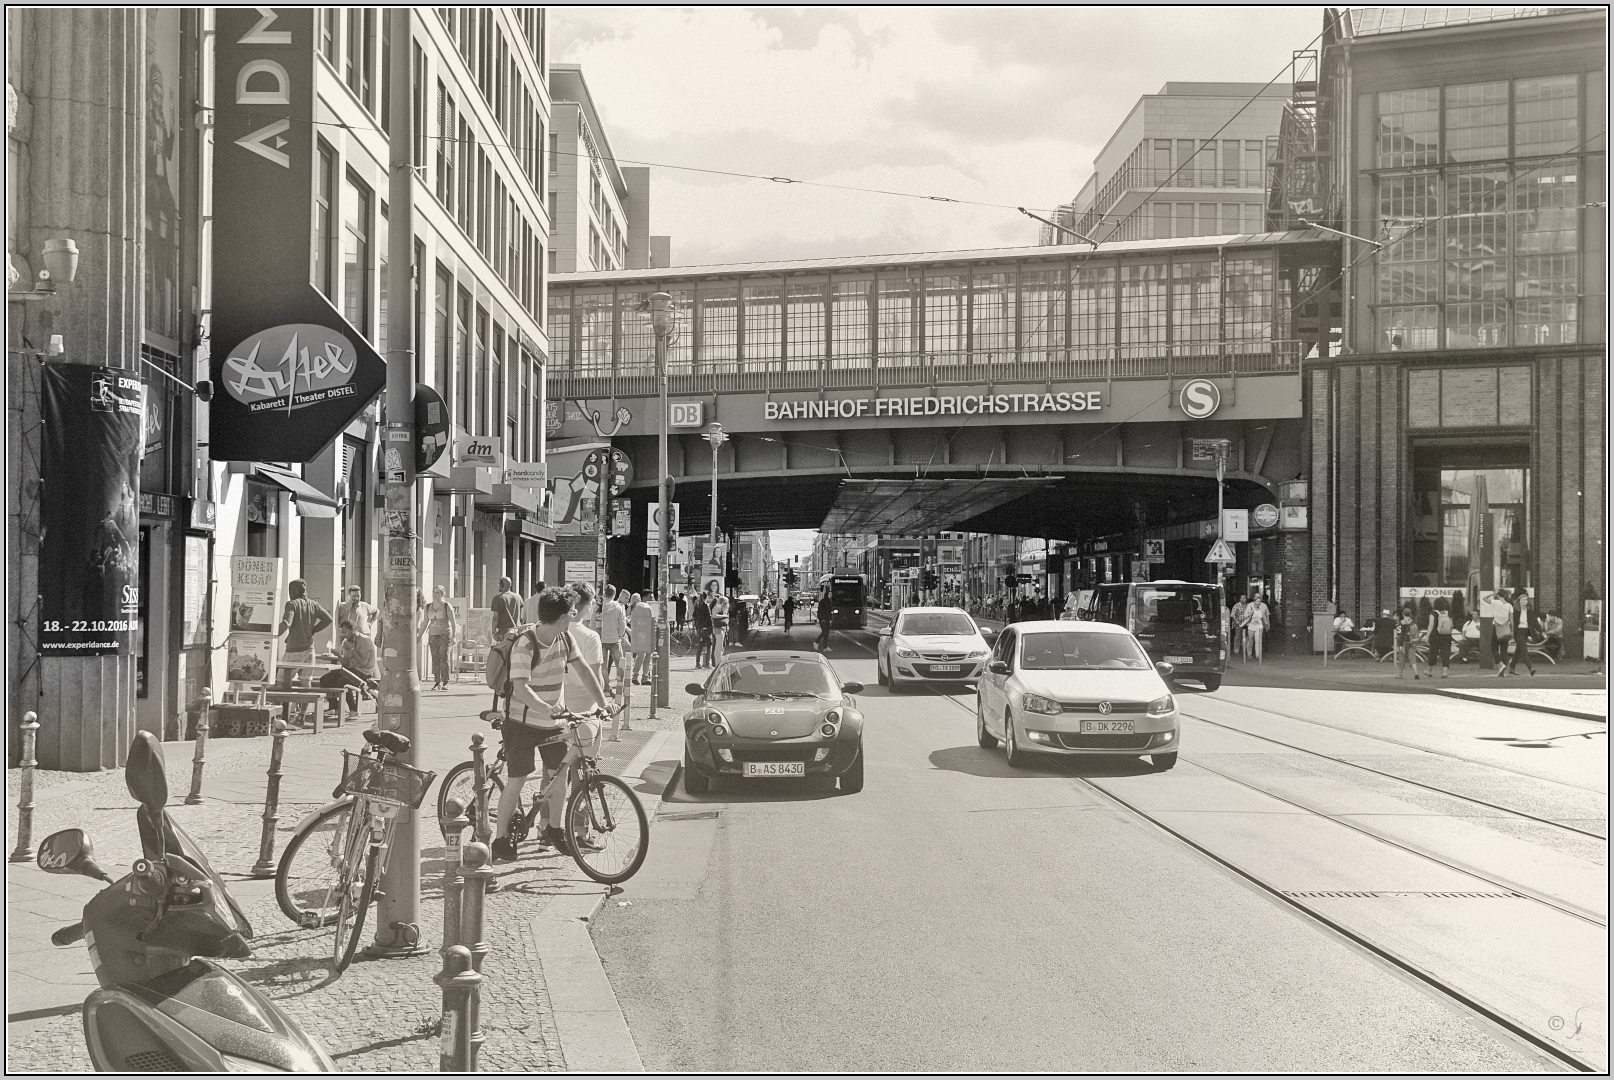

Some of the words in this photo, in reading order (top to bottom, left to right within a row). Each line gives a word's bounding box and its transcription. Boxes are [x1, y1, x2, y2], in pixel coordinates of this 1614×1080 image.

[250, 399, 286, 412] Kabarett
[294, 392, 326, 404] Theater
[327, 386, 355, 397] DISTEL
[764, 398, 869, 420] BAHNHOF
[875, 391, 1101, 417] FRIEDRICHSTRASSE
[1186, 382, 1214, 416] S
[673, 405, 698, 423] DB
[467, 441, 492, 455] dm
[237, 558, 273, 572] DÖNER
[237, 573, 272, 585] KEBAP
[1425, 588, 1456, 596] DÖNE
[71, 620, 128, 632] 22.10.2016
[42, 641, 120, 650] www.experidance.de
[1086, 722, 1092, 731] B
[1097, 722, 1109, 731] DK
[1111, 722, 1134, 731] 2296
[750, 764, 757, 774] B
[763, 764, 776, 774] AS
[778, 763, 803, 774] 8430
